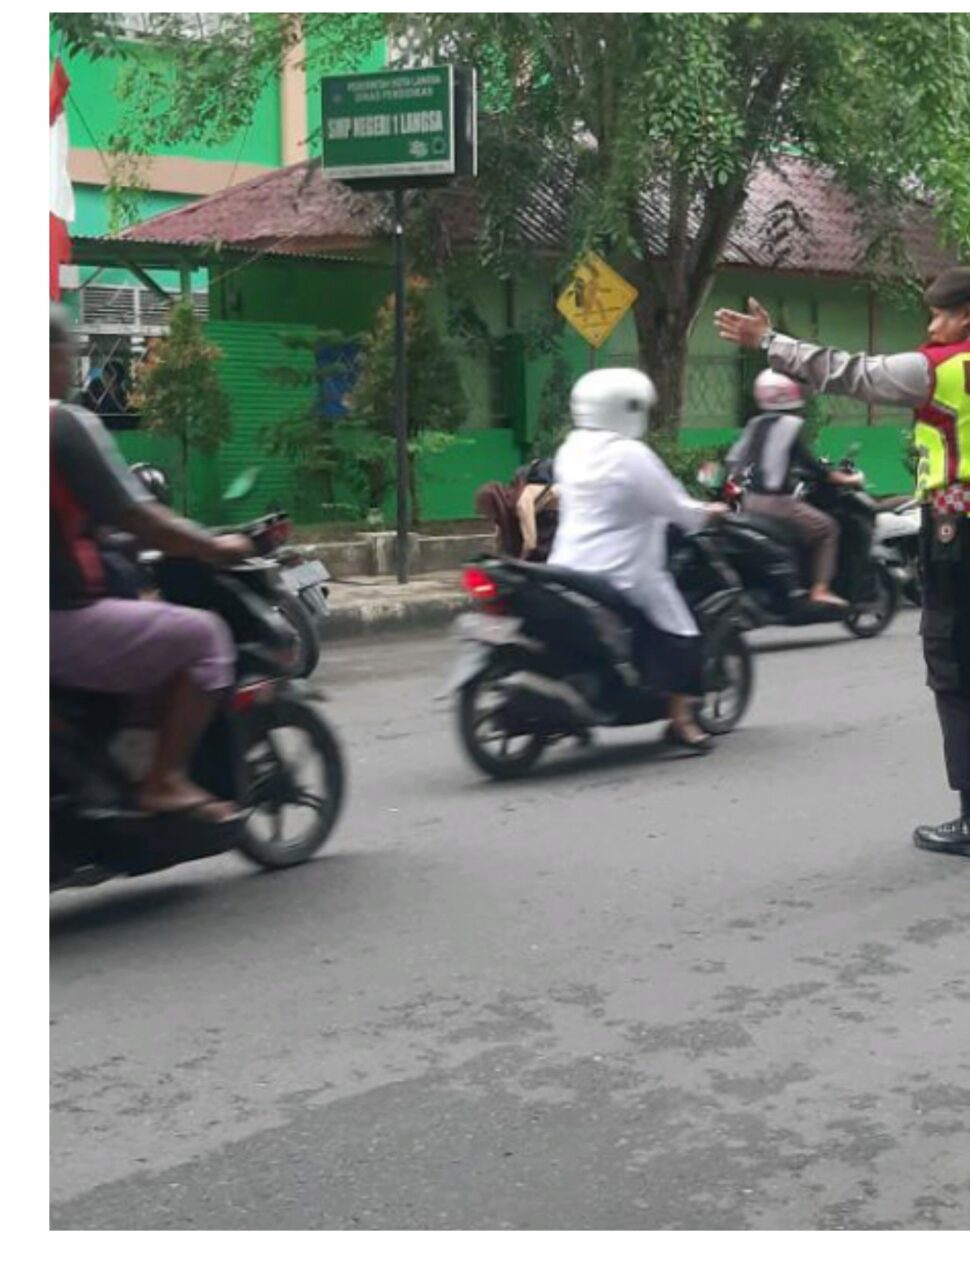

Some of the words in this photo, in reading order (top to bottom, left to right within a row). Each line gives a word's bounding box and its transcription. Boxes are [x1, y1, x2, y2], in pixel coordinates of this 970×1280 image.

[328, 117, 350, 139] SMP
[353, 114, 391, 138] NEGERI
[401, 110, 442, 134] LANGSA
